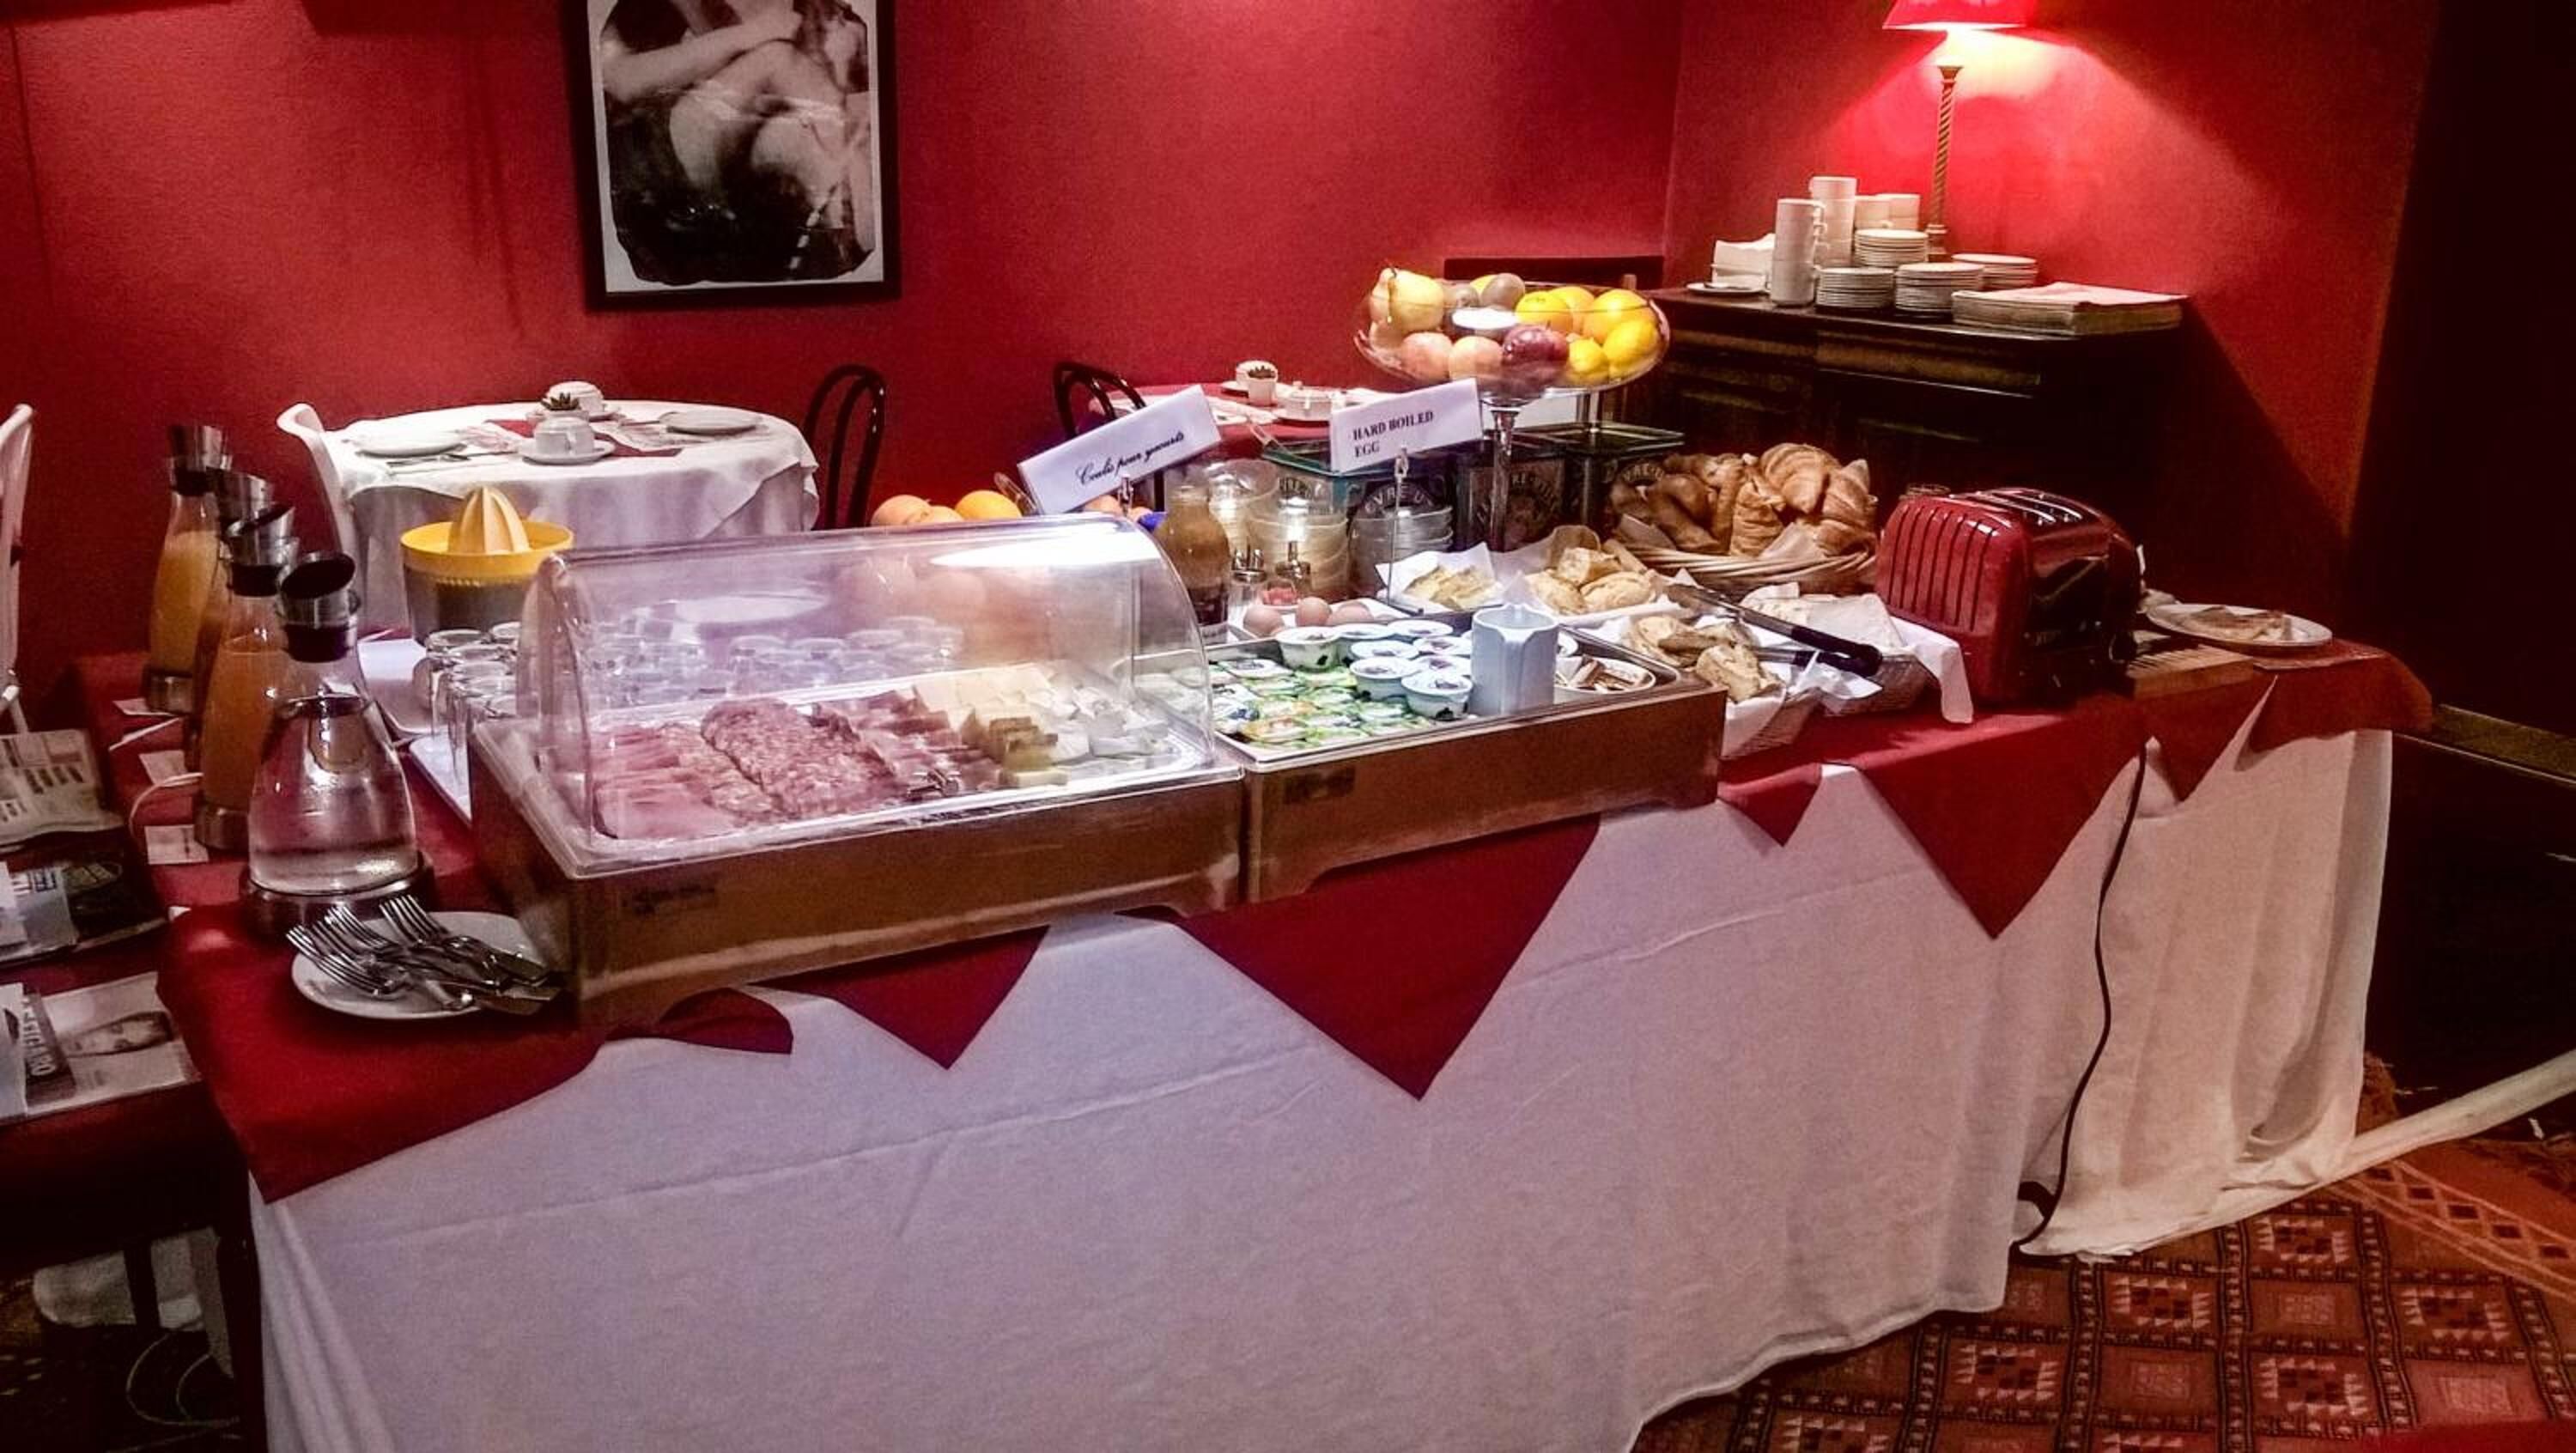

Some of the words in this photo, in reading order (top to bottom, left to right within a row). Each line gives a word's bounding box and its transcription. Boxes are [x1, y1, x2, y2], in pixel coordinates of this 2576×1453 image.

[1352, 422, 1387, 441] HARD
[1388, 410, 1433, 431] BOILED
[1354, 441, 1380, 458] EGG
